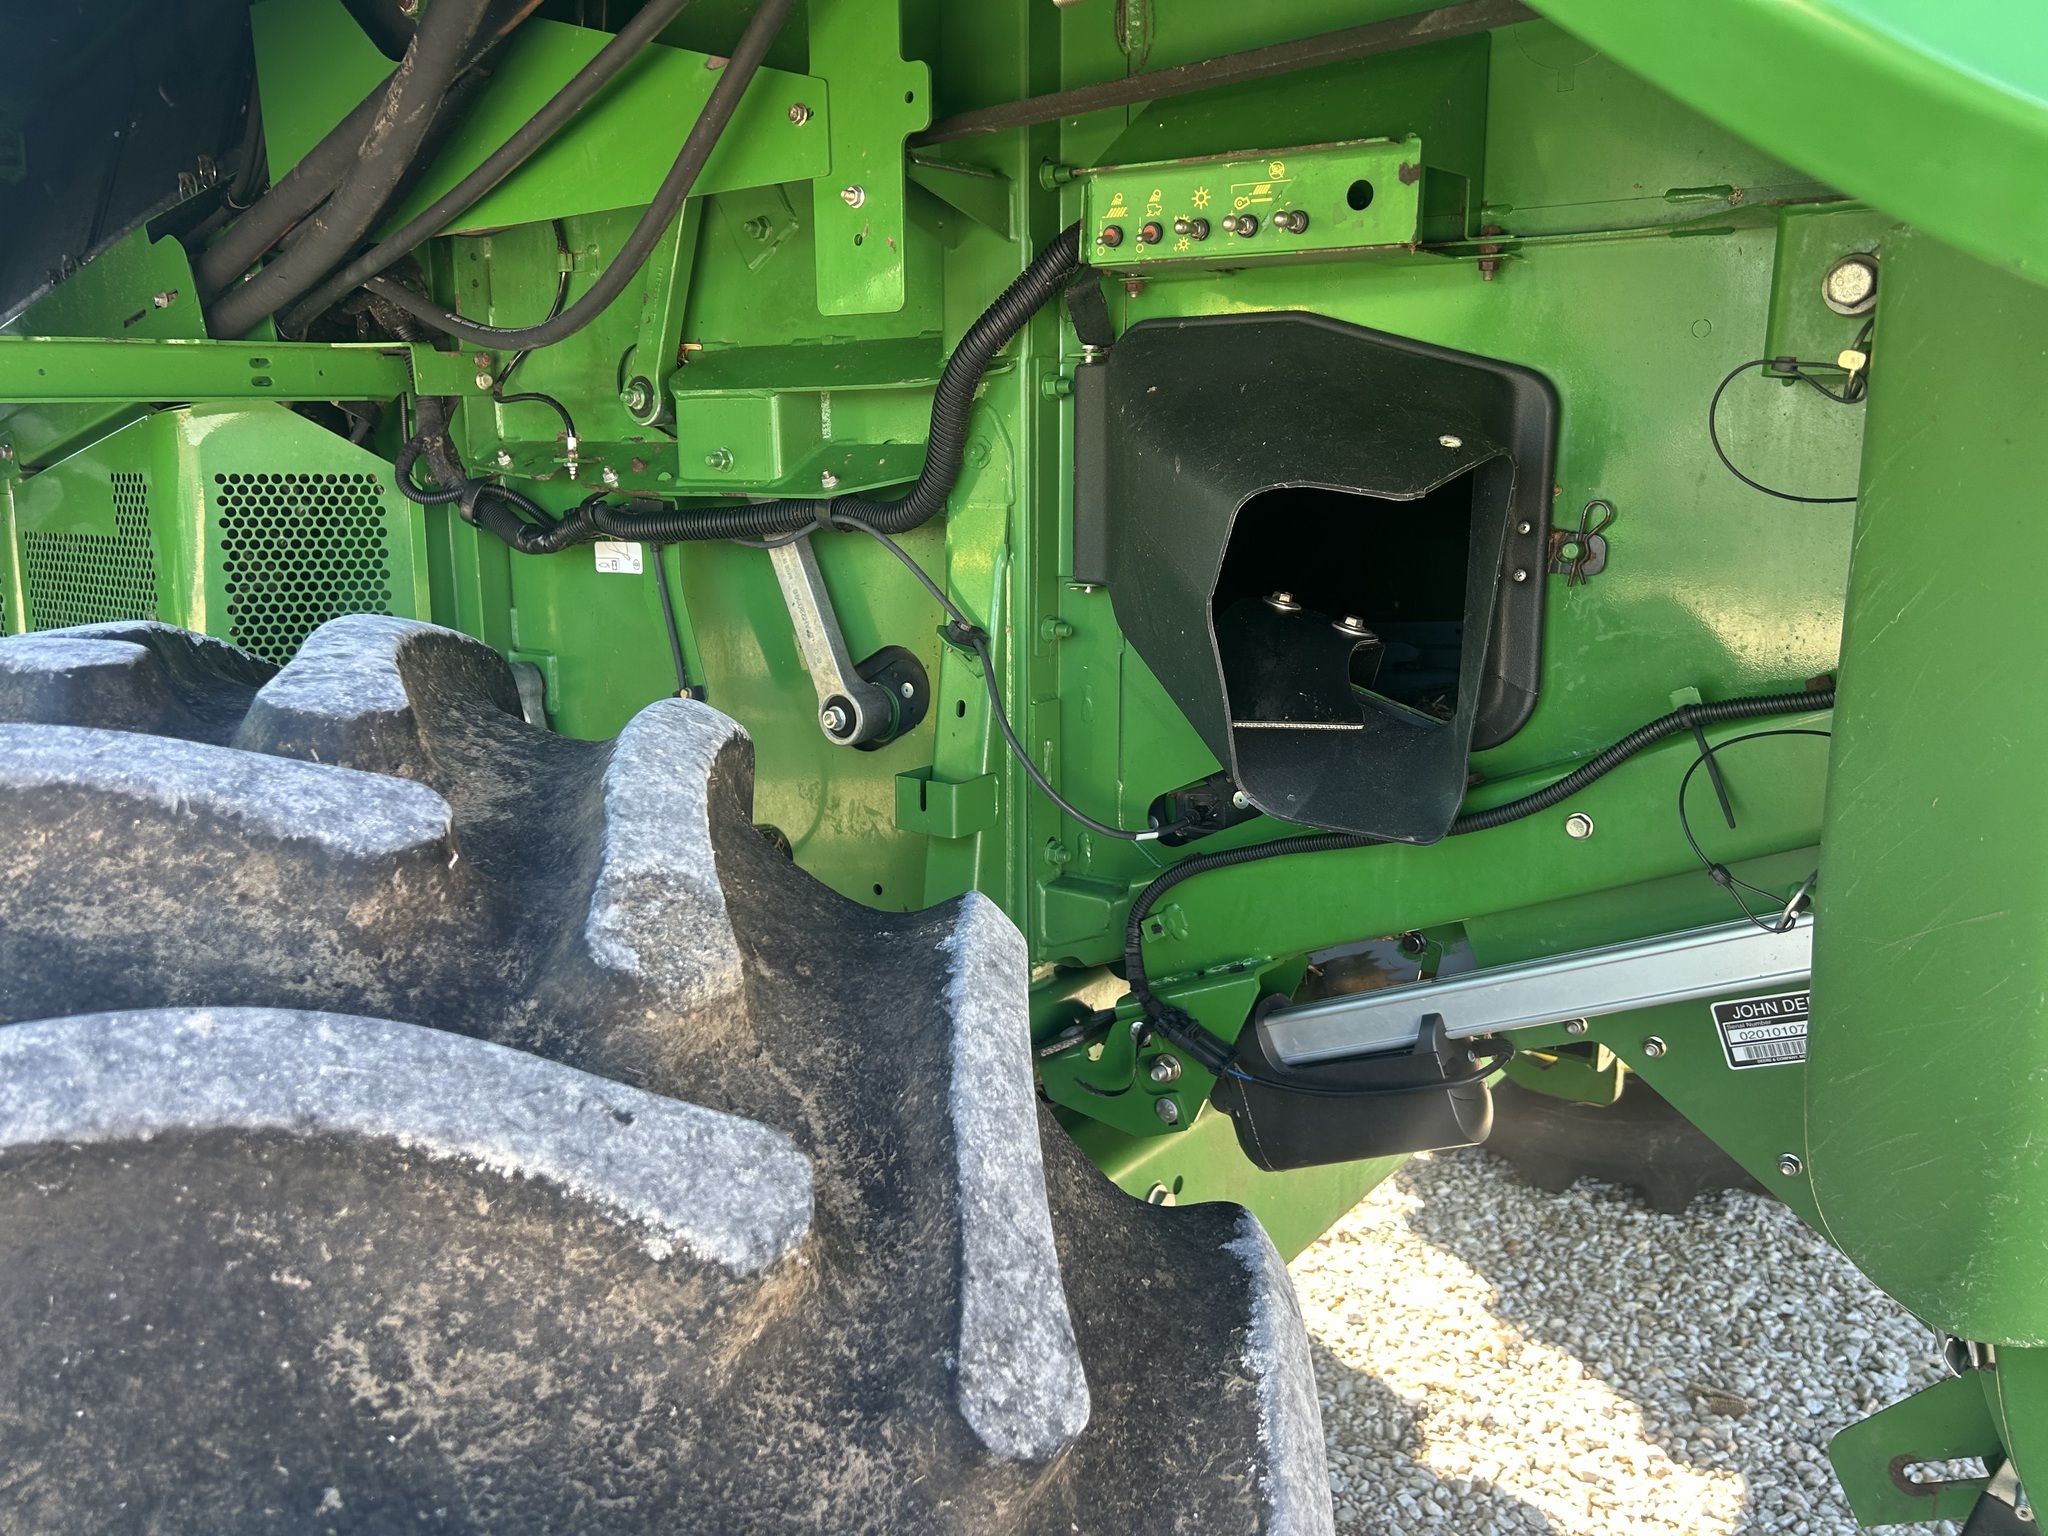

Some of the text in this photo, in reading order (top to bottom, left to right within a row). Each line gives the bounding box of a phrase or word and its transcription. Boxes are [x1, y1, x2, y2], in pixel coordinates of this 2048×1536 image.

[1732, 1001, 1778, 1019] JOHN
[1726, 1020, 1772, 1030] Serial Number
